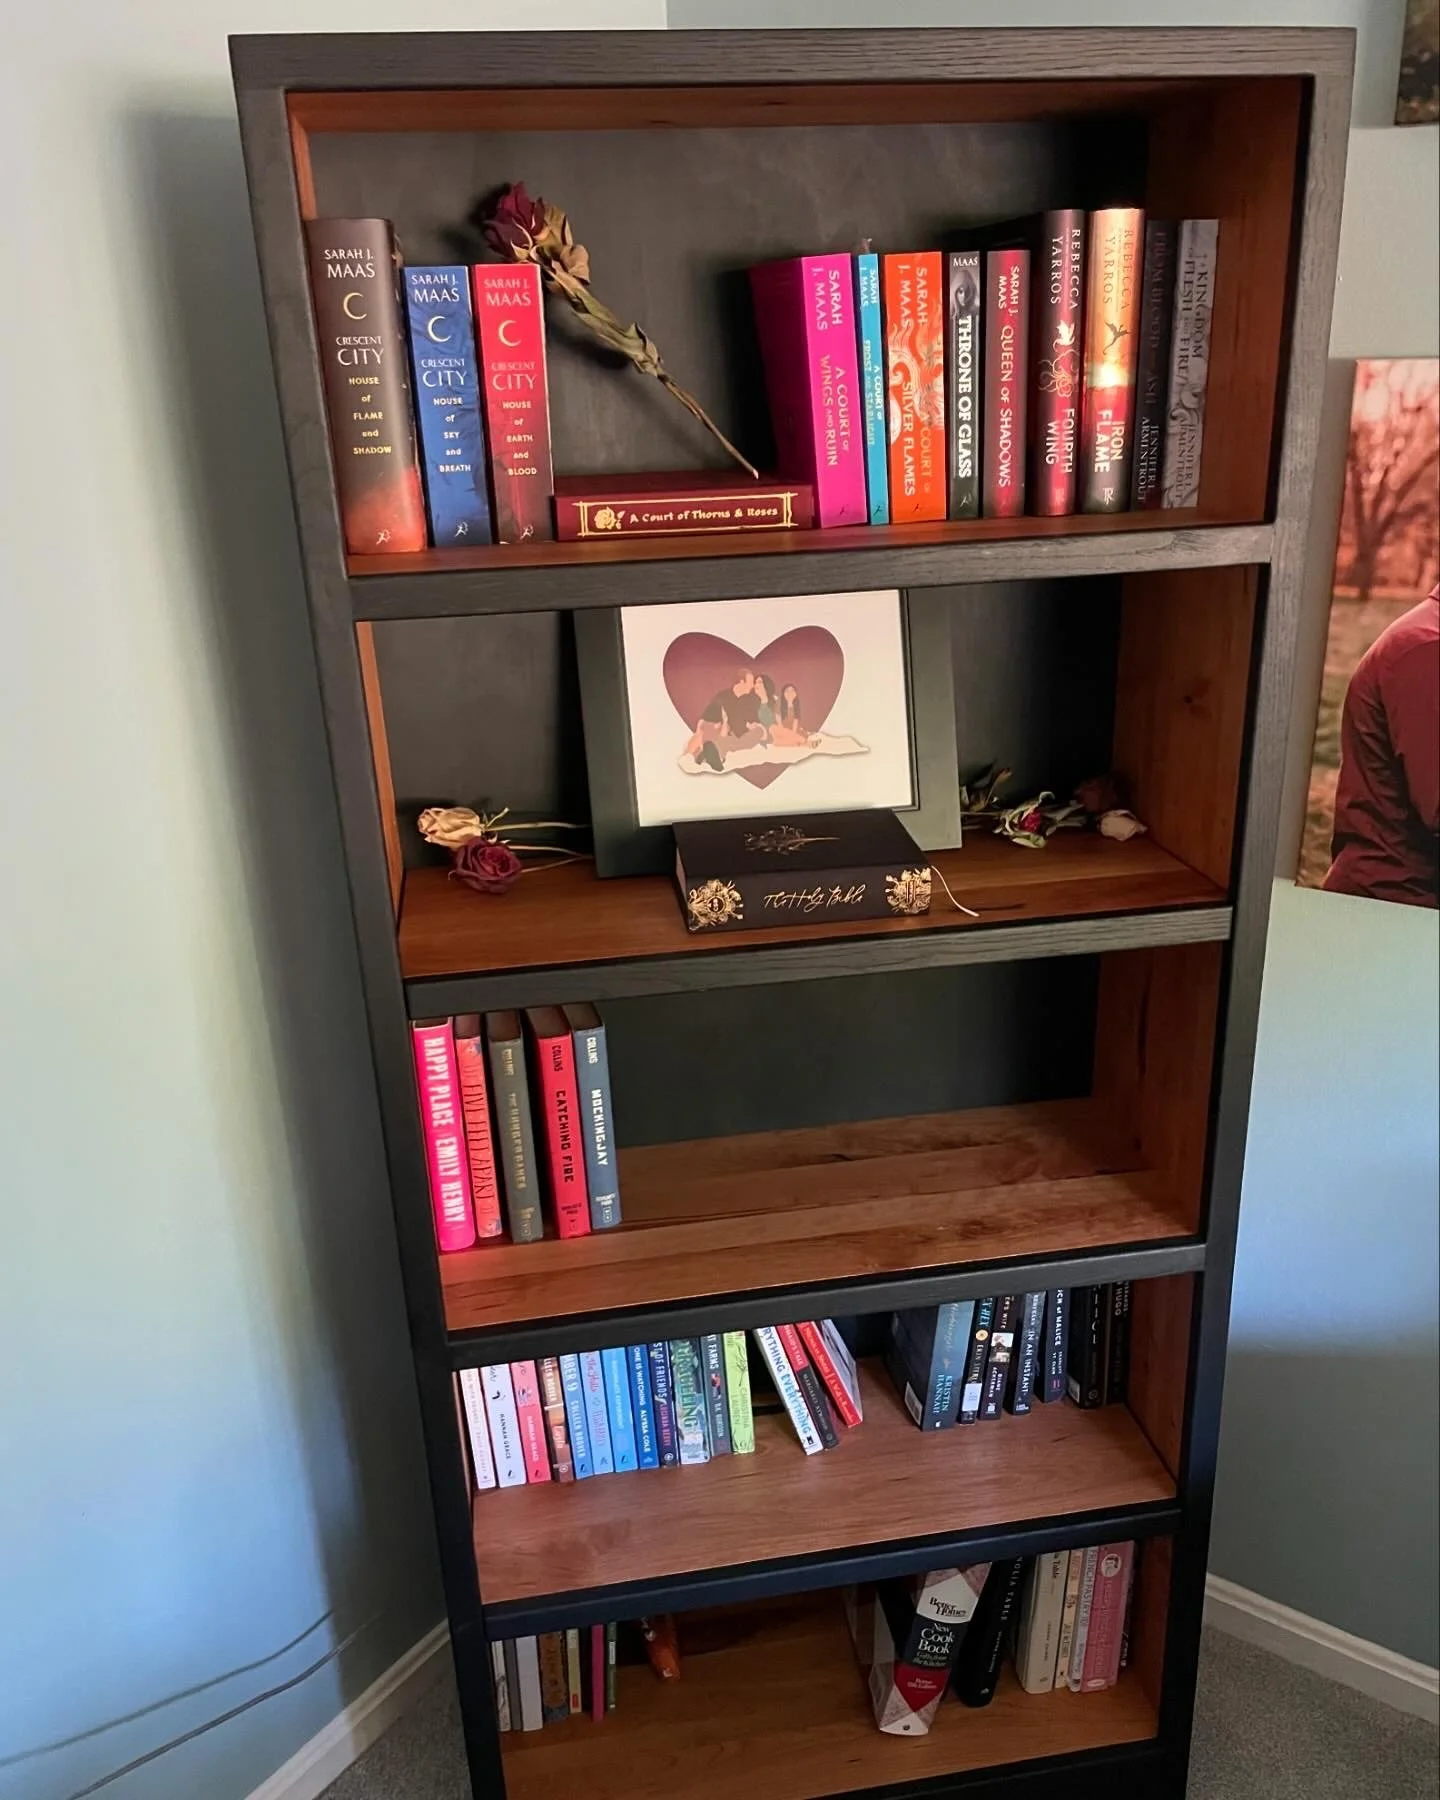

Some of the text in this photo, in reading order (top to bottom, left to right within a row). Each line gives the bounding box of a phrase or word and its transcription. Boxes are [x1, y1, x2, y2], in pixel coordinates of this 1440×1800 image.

[324, 248, 374, 261] SARAH J.
[953, 256, 978, 267] MAAS
[327, 263, 376, 279] MAAS
[412, 274, 459, 285] SARAH J.
[484, 277, 530, 289] SARAH J.
[1050, 235, 1063, 304] YARROS
[1069, 228, 1080, 310] REBECCA
[1103, 236, 1116, 305] YARROS
[1120, 228, 1133, 311] REBECCA
[414, 288, 460, 302] MAAS
[486, 292, 532, 306] MAAS
[811, 266, 828, 331] J. MAAS
[829, 269, 843, 326] SARAH
[860, 276, 869, 308] MAAS
[870, 269, 878, 305] SARAH
[897, 264, 912, 329] J. MAAS
[916, 268, 928, 324] SARAH
[998, 276, 1008, 309] MAAS
[1008, 266, 1020, 317] SARAH J.
[1178, 260, 1195, 373] FLESH FIRE
[1192, 271, 1208, 358] KINGDOM
[336, 336, 382, 346] CRESCENT
[337, 348, 384, 366] CITY
[421, 358, 466, 368] CRESCENT
[492, 362, 536, 371] CRESCENT
[348, 376, 380, 385] HOUSE
[422, 370, 466, 387] CITY
[492, 374, 537, 391] CITY
[835, 367, 846, 379] A
[362, 394, 371, 403] of
[433, 396, 462, 406] HOUSE
[864, 340, 875, 446] FROST STARLIGHT
[874, 366, 882, 410] A COURT
[958, 316, 972, 478] THRONE OF GLASS
[353, 411, 384, 420] FLAME
[446, 414, 455, 423] of
[503, 400, 532, 409] HOUSE
[820, 354, 838, 466] WINGS AND RUIN
[836, 386, 850, 437] COURT
[998, 326, 1014, 488] QUEEN OF SHADOWS
[362, 429, 379, 438] and
[444, 431, 460, 440] SKY
[514, 418, 524, 426] of
[353, 446, 392, 455] SHADOW
[446, 447, 462, 456] and
[506, 434, 533, 443] EARTH
[902, 382, 916, 497] SILVER FLAMES
[918, 412, 932, 478] A COURT
[1045, 422, 1058, 466] WING
[1061, 408, 1074, 474] FOURTH
[1094, 409, 1112, 473] FLAME
[1111, 420, 1124, 460] IRON
[1184, 423, 1197, 478] JENNIFER
[514, 450, 529, 460] and
[1138, 416, 1150, 502] ARMENTROUT
[1148, 425, 1160, 482] JENNIFER
[439, 464, 471, 472] BREATH
[508, 467, 537, 476] BLOOD
[630, 506, 778, 524] A Court of Thorns & Roses
[764, 884, 866, 912] The Holy Bible
[552, 1045, 563, 1072] COLLINS
[586, 1037, 598, 1064] COLLINS
[424, 1037, 466, 1223] HAPPY PLACE EMILY HENRY
[556, 1090, 574, 1182] CATCHING FIRE
[592, 1089, 608, 1166] MOCKINGJAY
[463, 1084, 494, 1200] FIVE FEET APART
[1115, 1288, 1123, 1316] HUGO
[655, 1352, 664, 1364] OF
[708, 1344, 719, 1369] FARMS
[976, 1344, 984, 1360] ERIN
[1021, 1330, 1035, 1392] IN AN INSTANT
[636, 1371, 646, 1406] WATCHING
[656, 1366, 668, 1398] FRIENDS
[763, 1328, 811, 1433] RYTHING EVERYTHING
[933, 1374, 944, 1413] HANNAH
[941, 1376, 952, 1412] KRISTIN
[988, 1366, 997, 1398] ACKERMAN
[570, 1400, 586, 1458] COLLEEN HOOVER
[640, 1410, 649, 1433] ALYSSA
[500, 1414, 512, 1460] HANNAH GRACE
[643, 1434, 651, 1453] COLE
[1052, 1560, 1060, 1579] Table
[930, 1597, 956, 1610] Better
[936, 1606, 966, 1616] Homes
[1001, 1592, 1014, 1621] TABLE
[921, 1628, 953, 1643] Cook
[934, 1623, 950, 1632] New
[918, 1639, 949, 1654] Book
